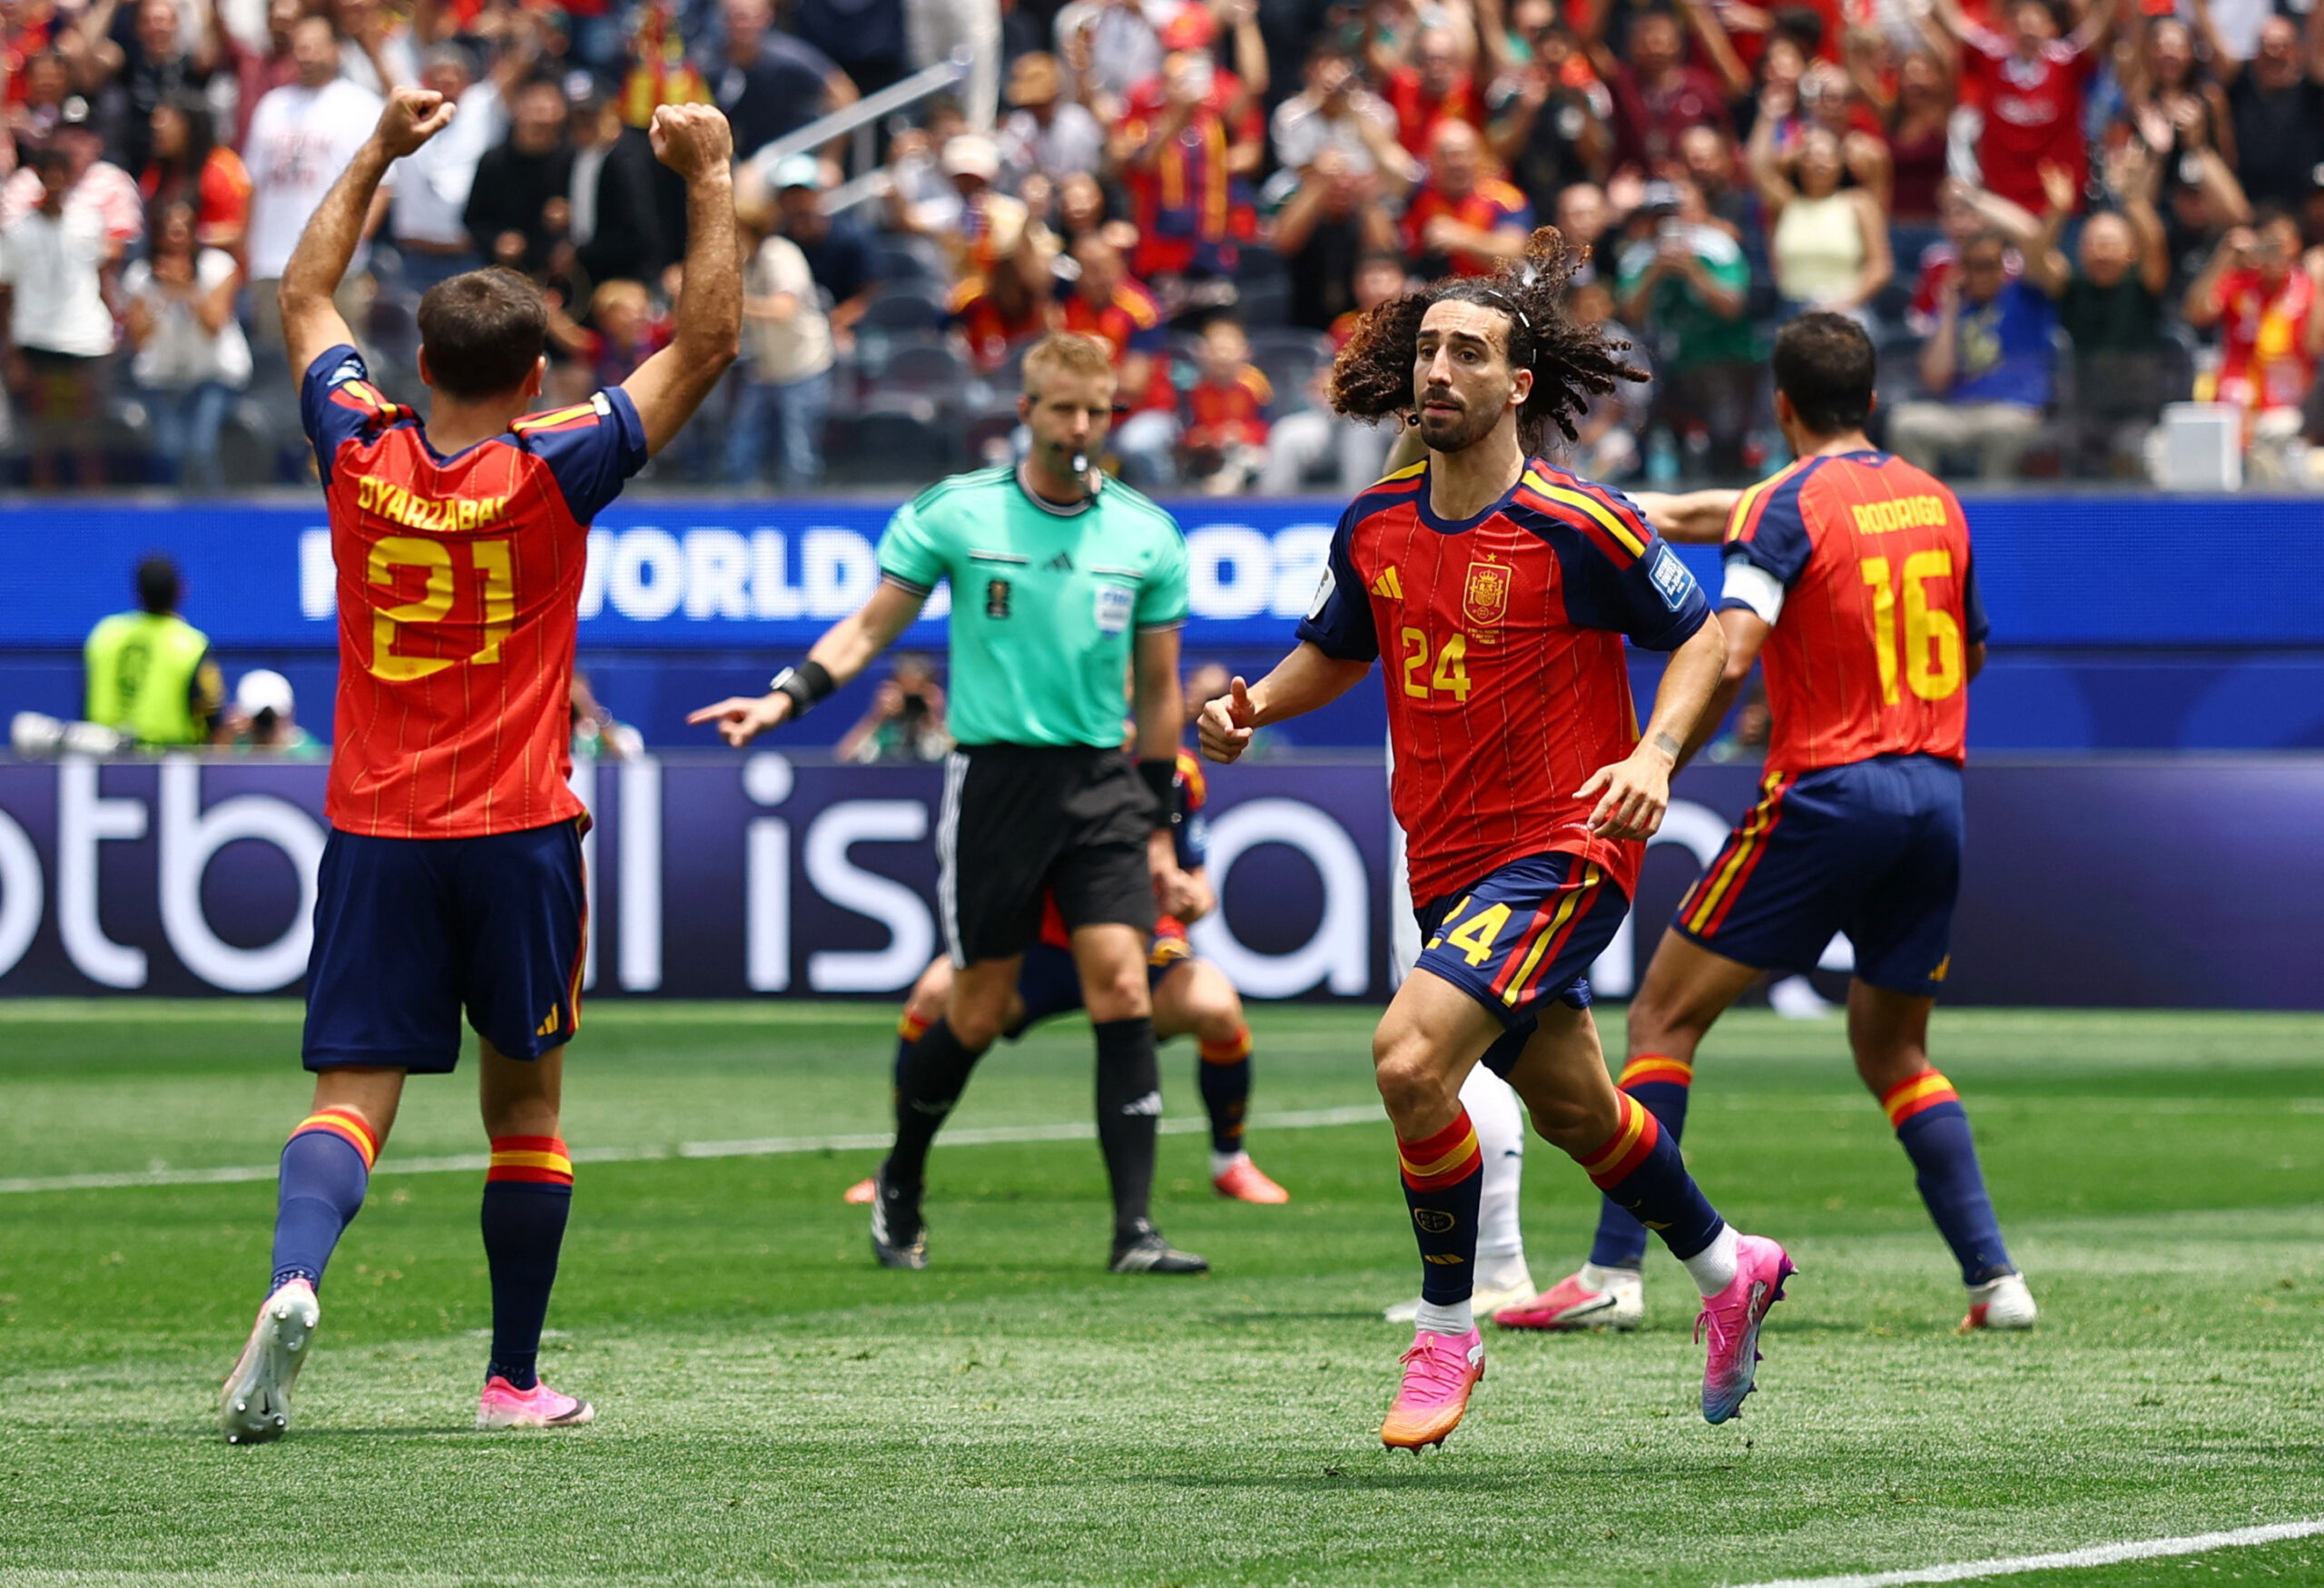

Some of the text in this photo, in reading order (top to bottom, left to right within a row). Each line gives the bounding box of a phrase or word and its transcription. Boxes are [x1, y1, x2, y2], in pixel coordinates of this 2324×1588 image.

[1851, 495, 1947, 536] RODRIGO
[367, 536, 516, 682] 21
[1401, 627, 1471, 701] 24
[1861, 549, 1962, 705] 16
